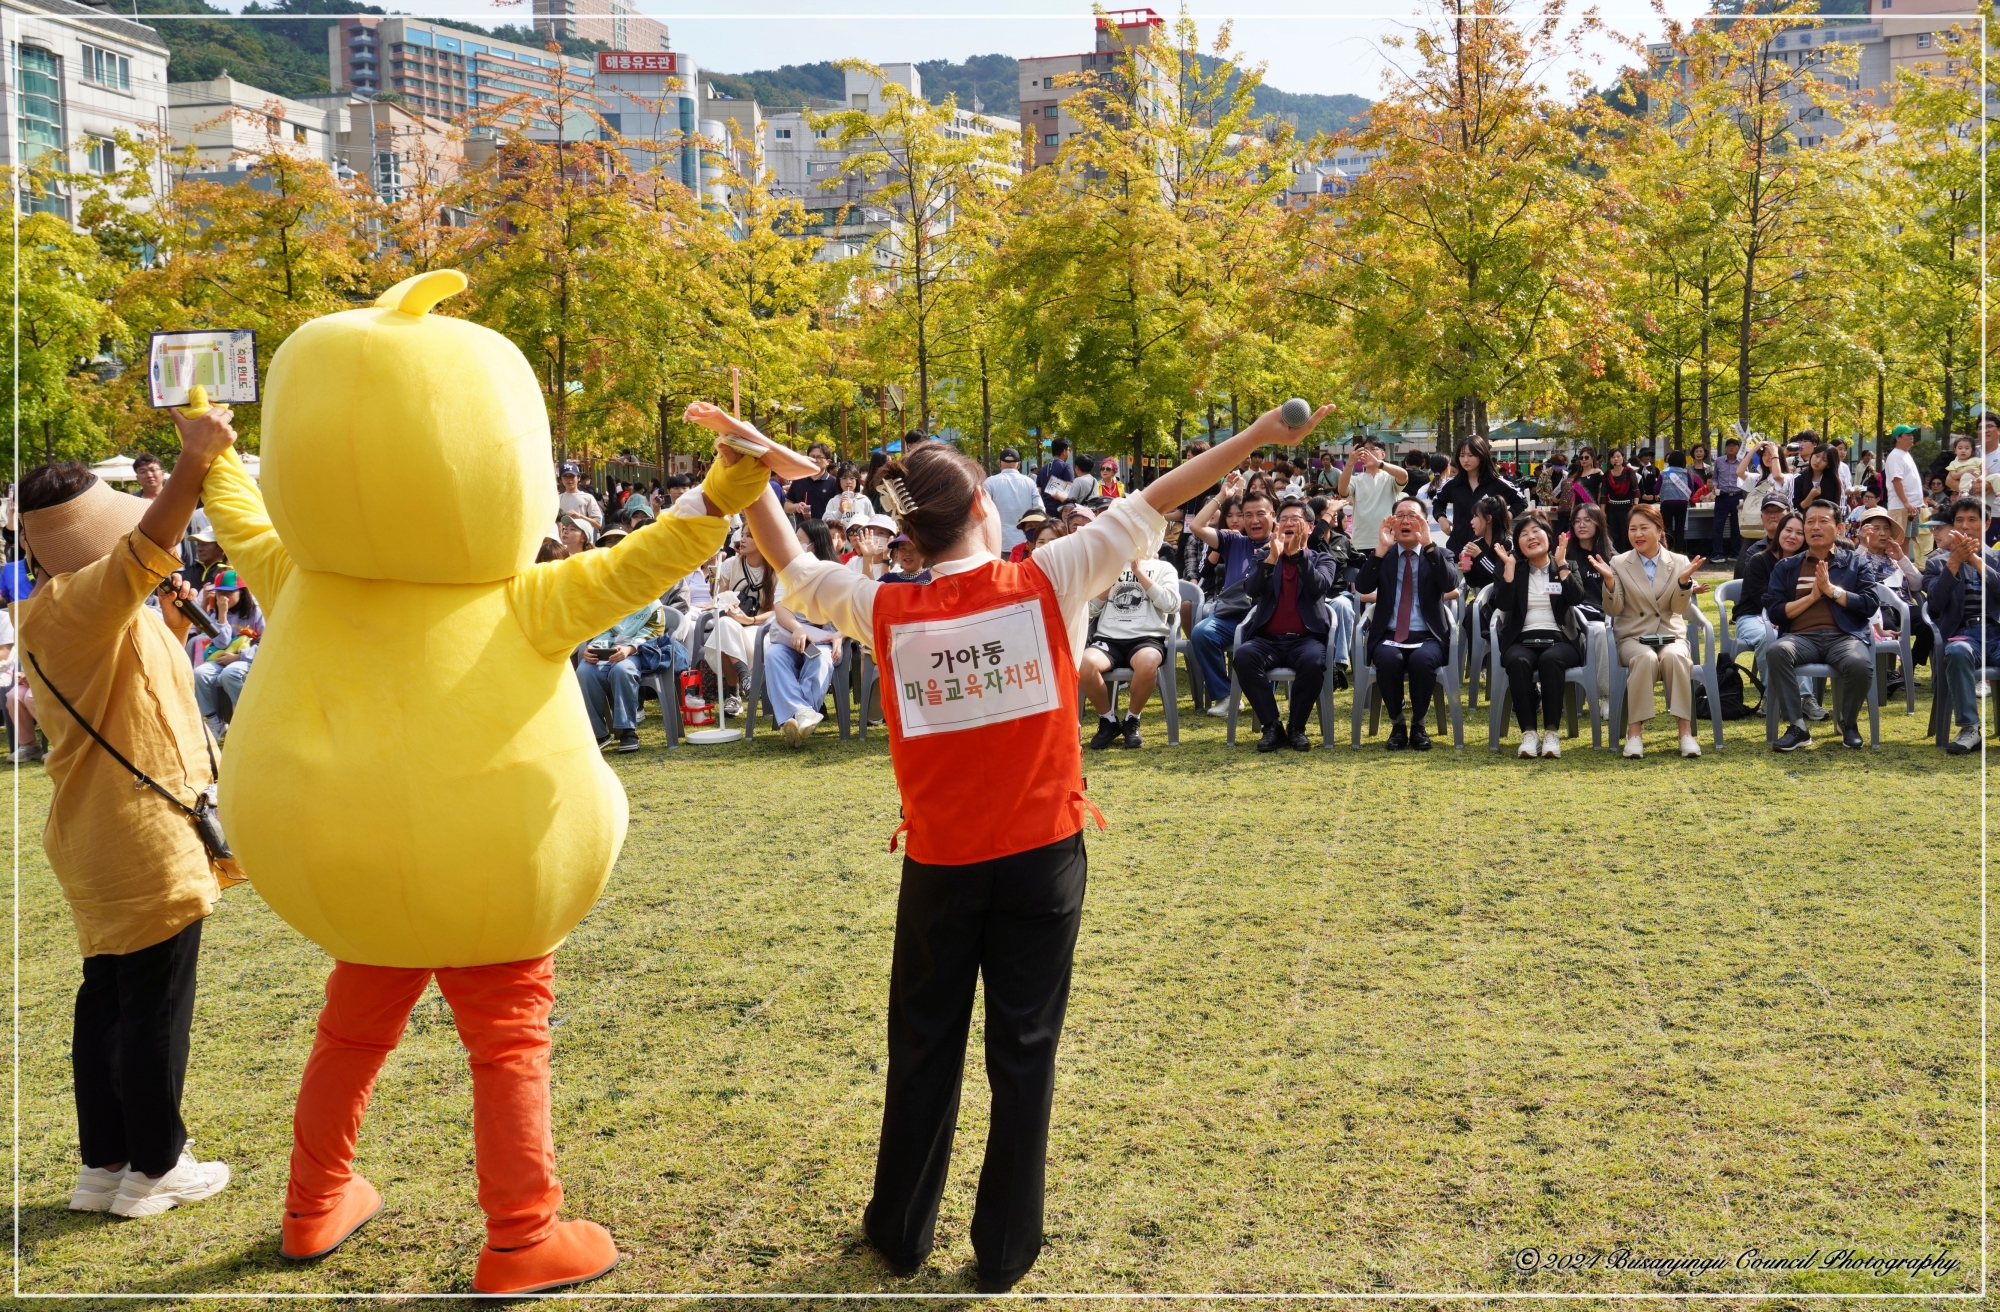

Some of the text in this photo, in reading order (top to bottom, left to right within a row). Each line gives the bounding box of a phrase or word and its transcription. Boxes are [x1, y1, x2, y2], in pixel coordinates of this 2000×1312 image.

[605, 56, 670, 69] 해동유도관
[236, 348, 248, 389] 축제 안내도
[563, 463, 573, 471] NY
[931, 640, 1005, 674] 가야동
[903, 659, 1042, 706] 마을교육자치회
